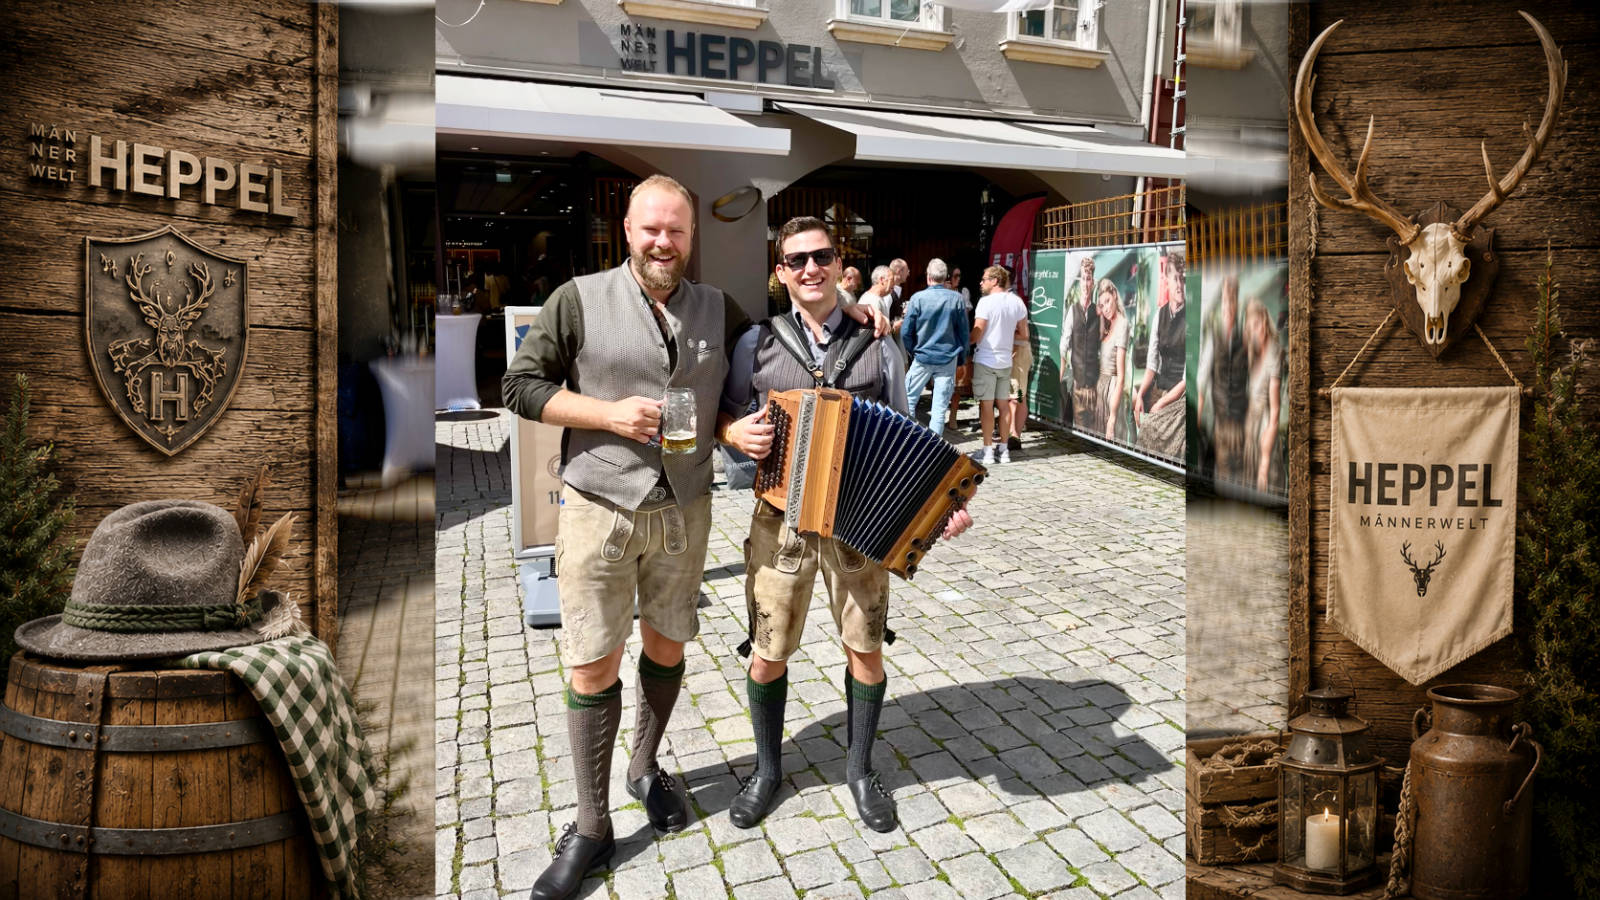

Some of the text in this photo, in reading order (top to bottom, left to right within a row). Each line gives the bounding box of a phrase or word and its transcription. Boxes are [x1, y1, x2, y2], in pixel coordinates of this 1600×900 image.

[621, 39, 656, 55] NER
[666, 29, 835, 90] HEPPEL
[620, 57, 657, 72] WELT
[31, 142, 77, 163] NER
[30, 163, 77, 182] WELT
[87, 135, 298, 218] HEPPEL
[150, 371, 189, 421] H
[1348, 461, 1503, 508] HEPPEL
